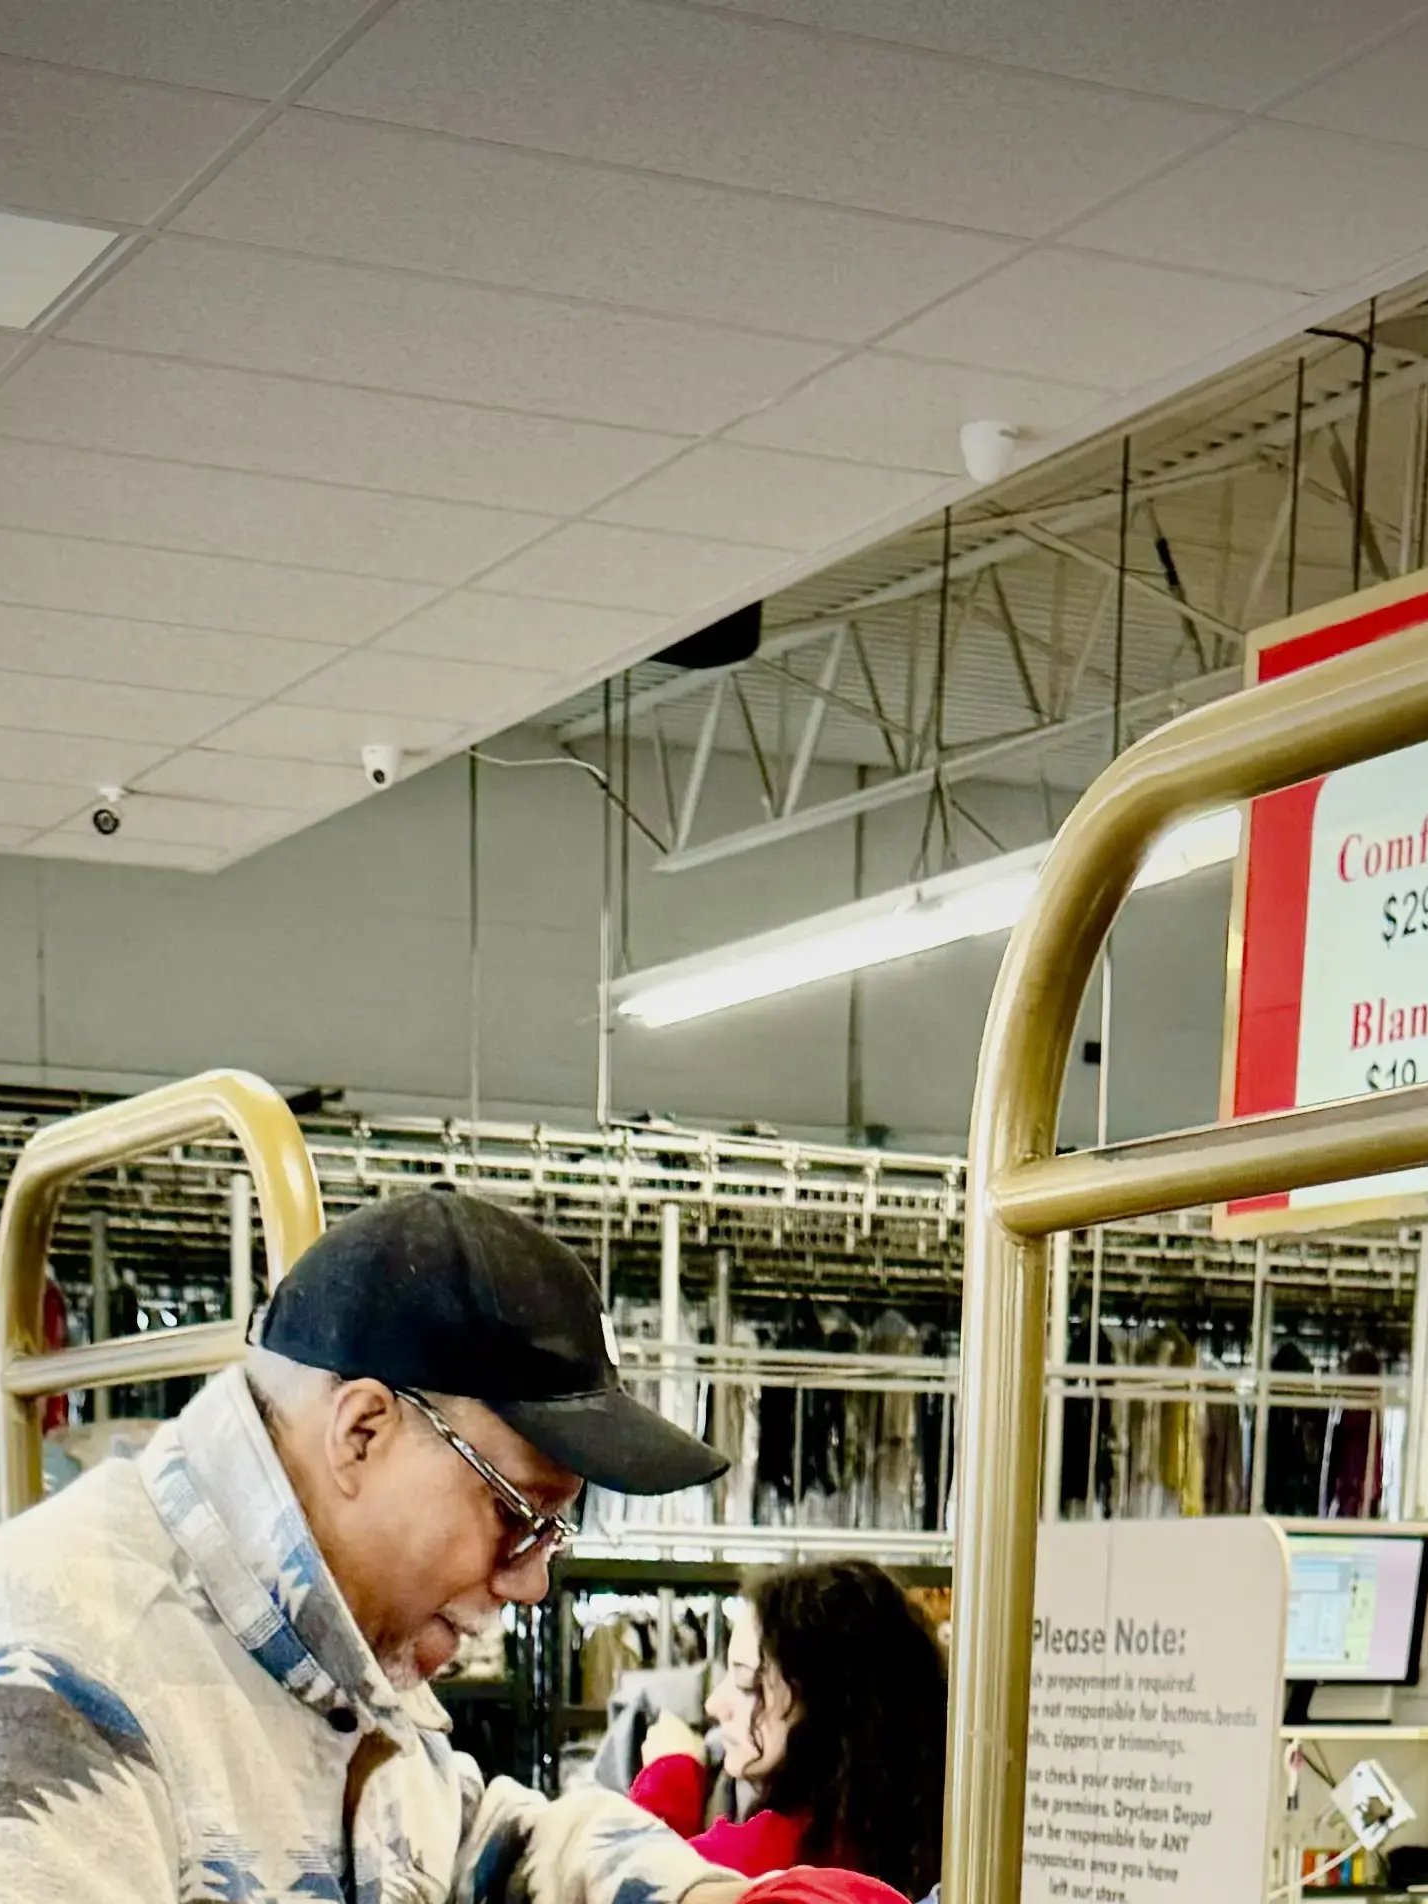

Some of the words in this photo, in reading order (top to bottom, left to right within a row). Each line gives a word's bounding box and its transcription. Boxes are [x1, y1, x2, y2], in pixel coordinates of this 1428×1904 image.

[1032, 1617, 1106, 1656] Please
[1115, 1617, 1187, 1656] Note:
[1113, 1799, 1169, 1825] Dryclean
